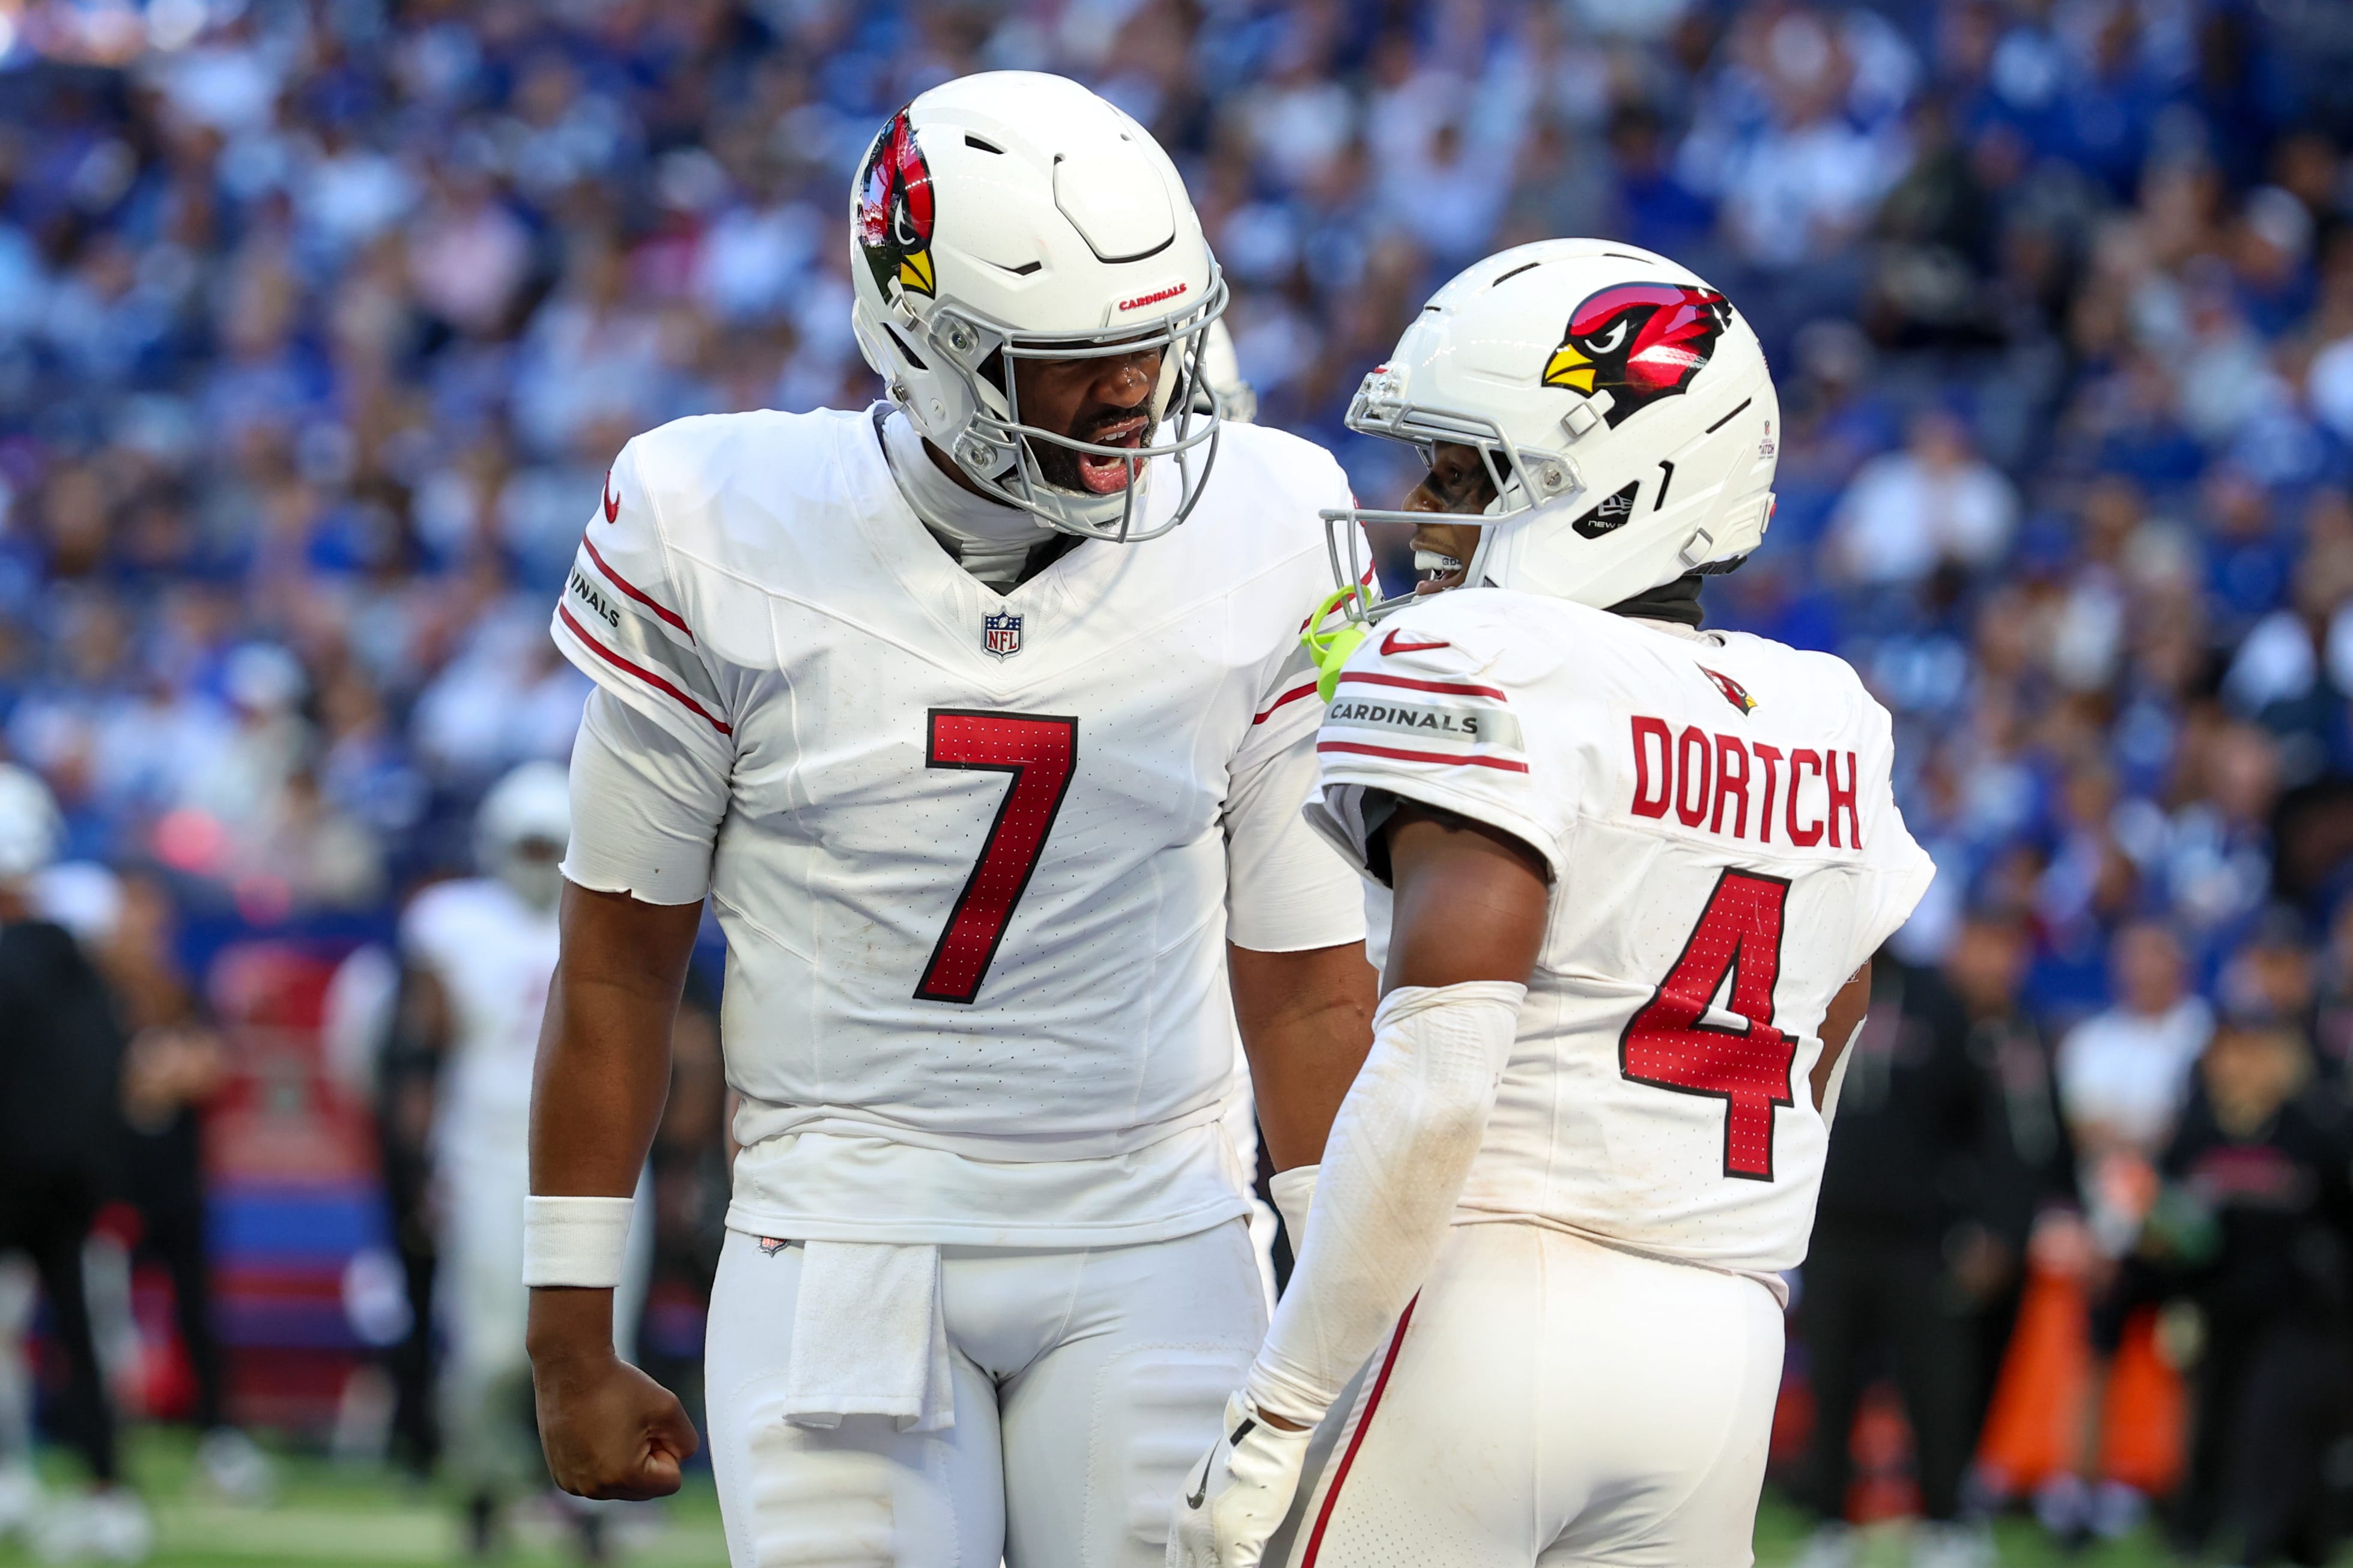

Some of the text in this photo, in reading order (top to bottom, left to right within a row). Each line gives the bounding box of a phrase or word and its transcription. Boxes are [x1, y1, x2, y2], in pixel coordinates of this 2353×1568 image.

[1119, 283, 1187, 311] CARDINALS
[571, 568, 620, 628] INALS
[988, 631, 1017, 652] NFL
[1331, 703, 1478, 734] CARDINALS
[1631, 715, 1862, 850] DORTCH
[912, 707, 1078, 1004] 7
[1618, 865, 1799, 1182] 4
